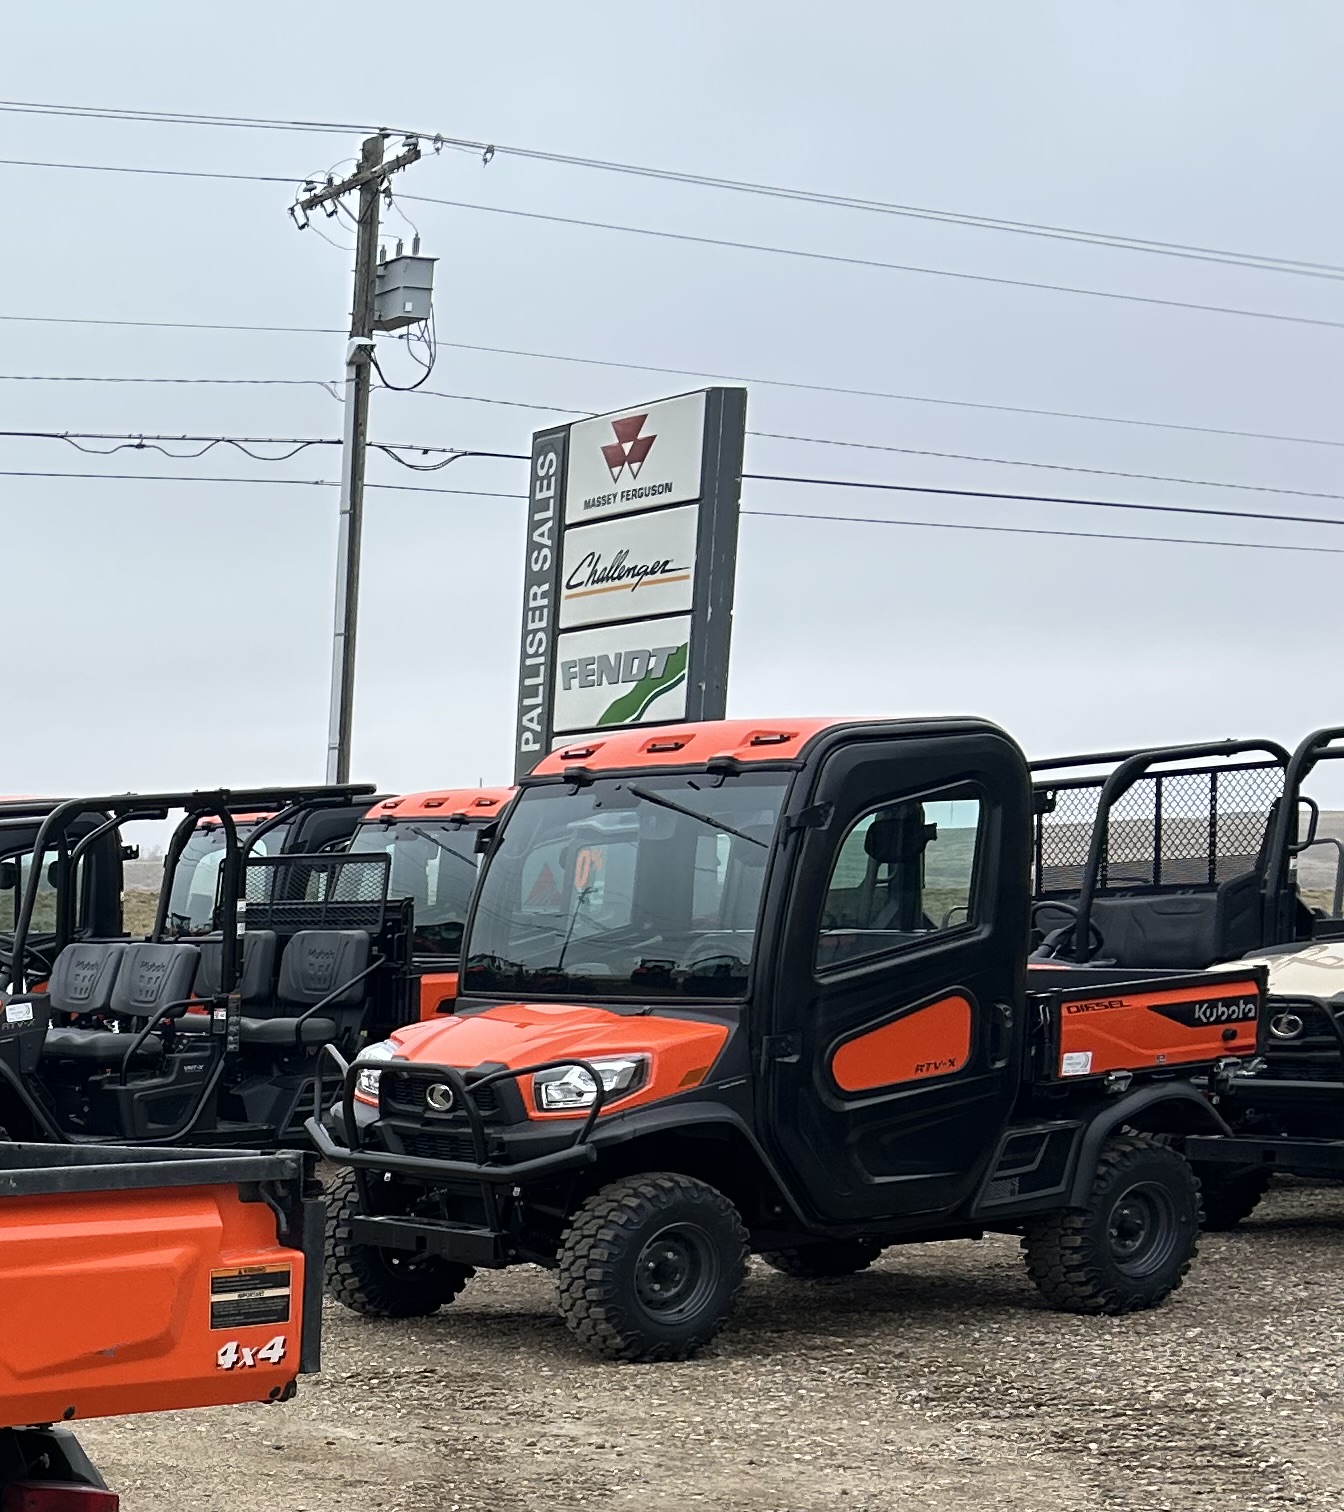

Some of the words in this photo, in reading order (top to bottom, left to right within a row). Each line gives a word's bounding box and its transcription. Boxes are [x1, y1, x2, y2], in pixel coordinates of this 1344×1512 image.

[531, 452, 557, 572] SALES
[583, 491, 618, 511] MASSEY
[620, 481, 673, 502] FERGUSON
[565, 549, 691, 592] Challenger
[520, 583, 550, 752] PALLISER
[561, 646, 679, 691] FENDT
[1066, 1000, 1133, 1014] DIESEL
[1194, 999, 1256, 1023] Kubota
[915, 1058, 956, 1074] RTV-X
[216, 1335, 288, 1370] 4x4
